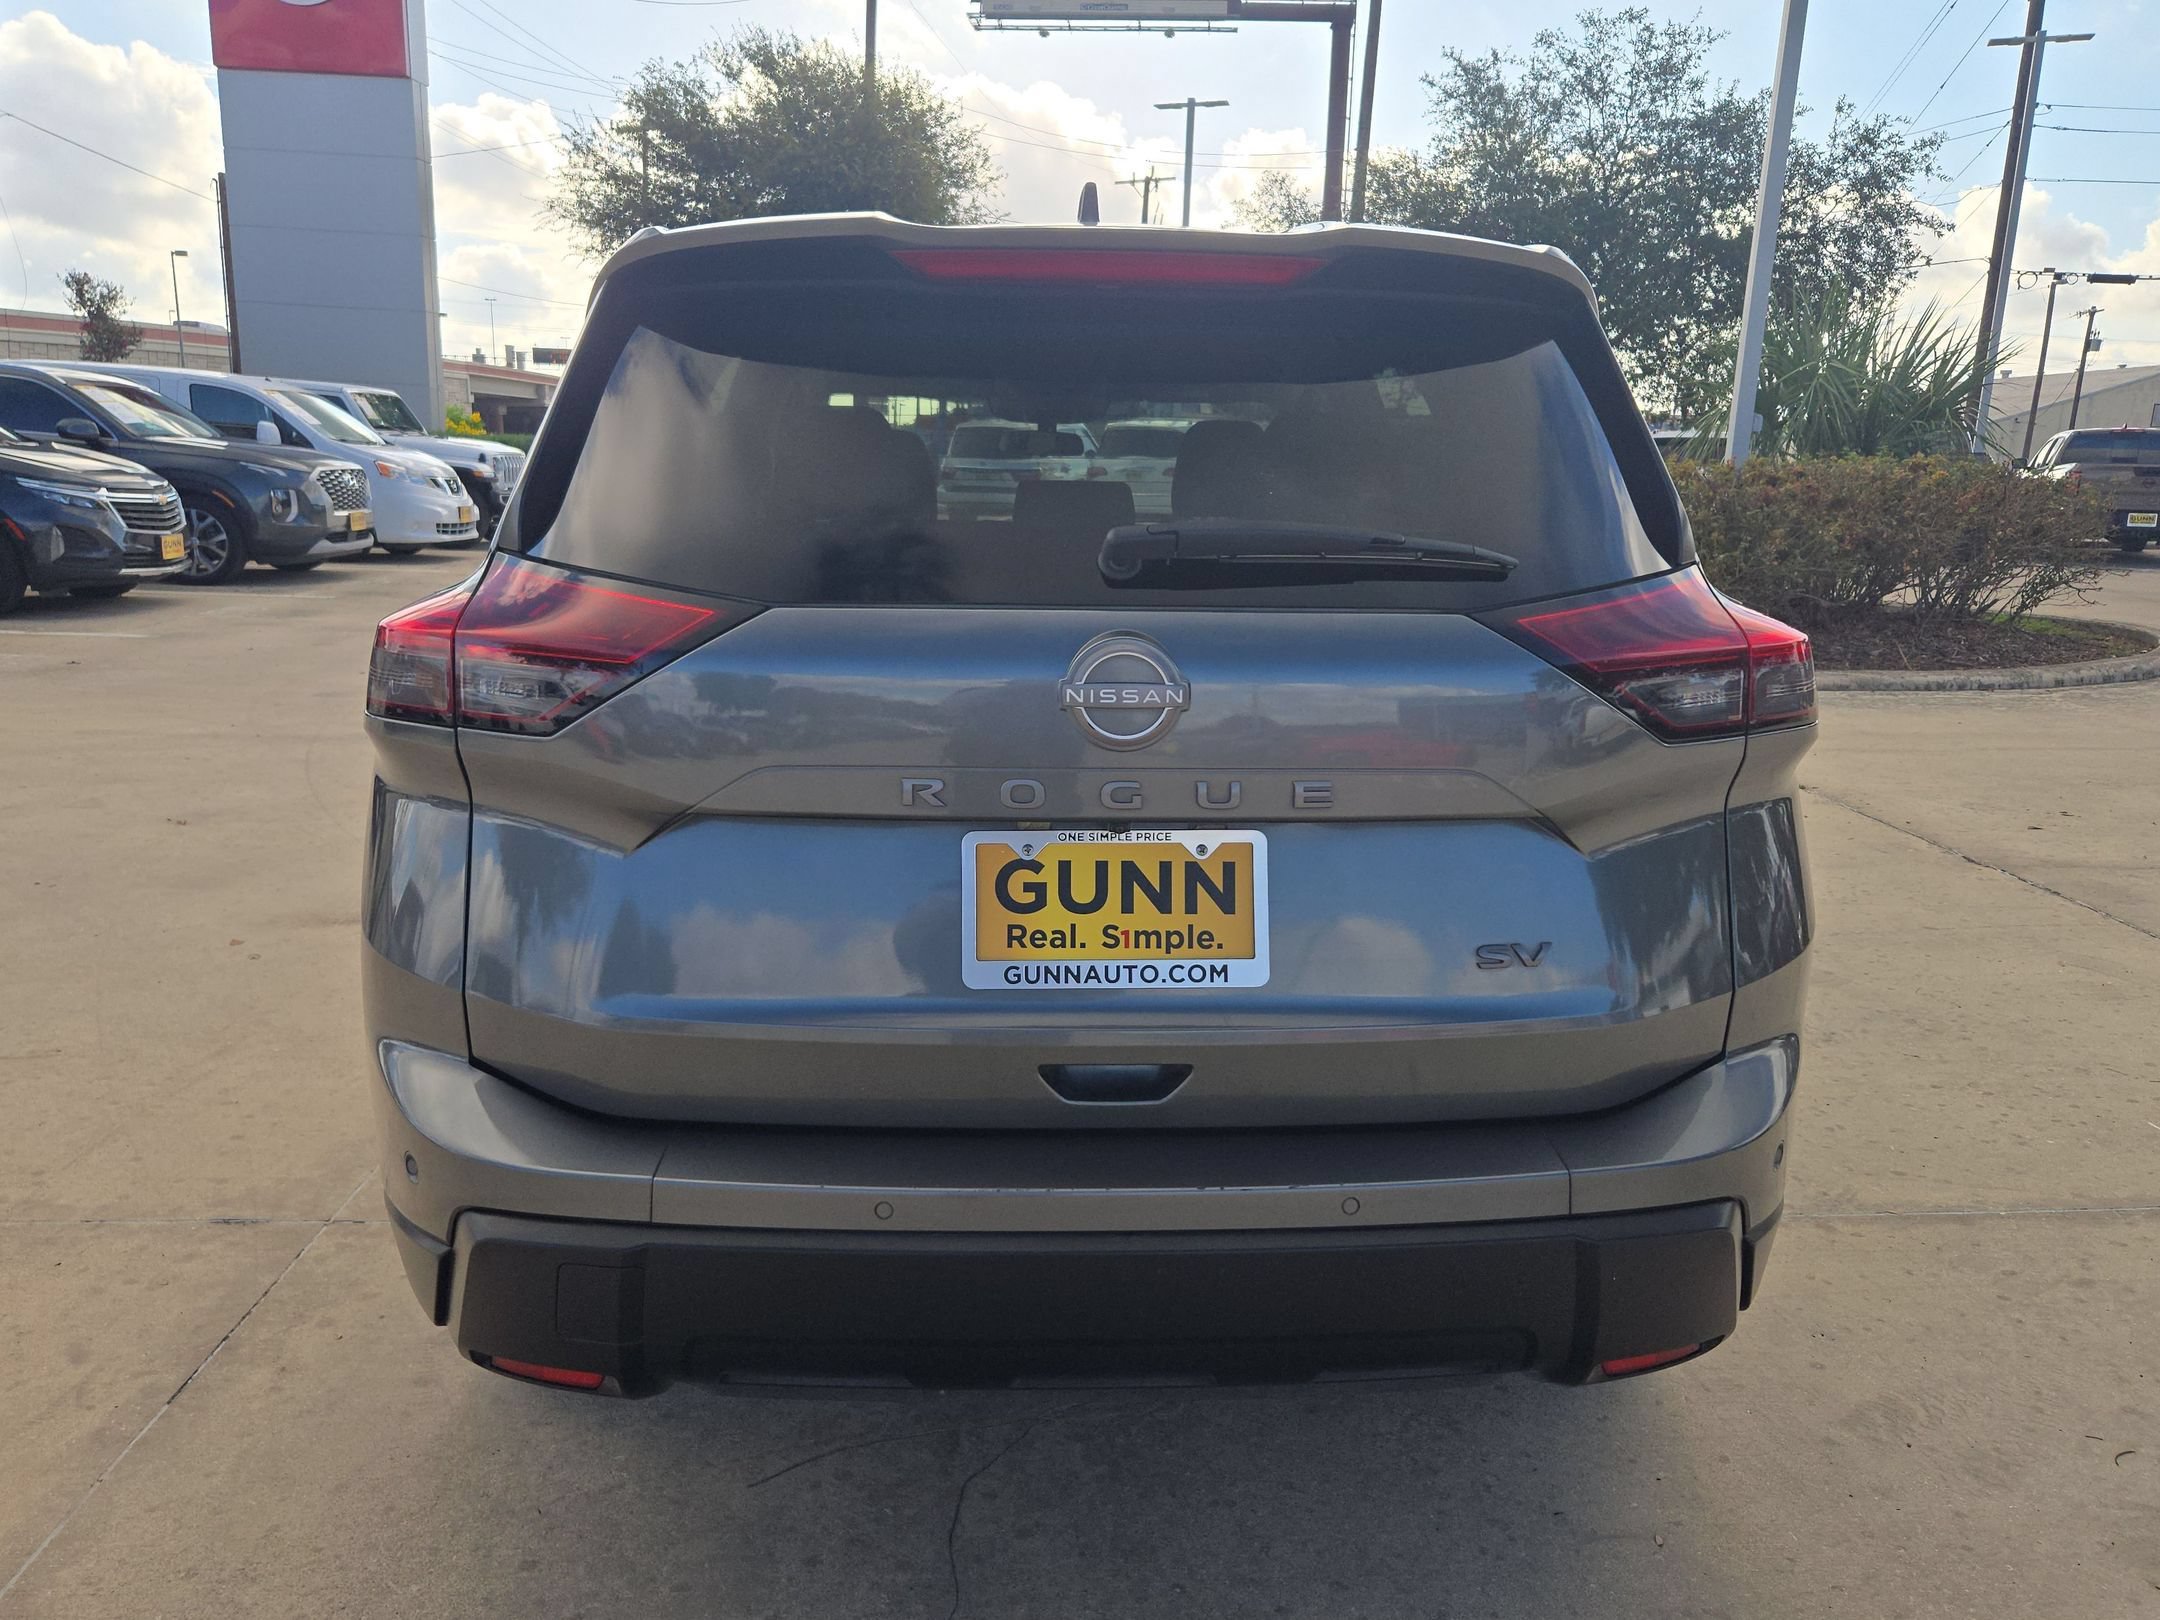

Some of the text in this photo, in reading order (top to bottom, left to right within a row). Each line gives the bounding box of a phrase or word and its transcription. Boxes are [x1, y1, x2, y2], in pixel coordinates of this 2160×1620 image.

[1066, 689, 1185, 704] NISSAN
[901, 777, 1334, 809] ROGUE
[1058, 832, 1172, 842] ONE SIMPLE PRICE
[995, 858, 1236, 915] GUNN
[1006, 923, 1086, 949] Real.
[1475, 942, 1553, 970] SV
[1003, 964, 1229, 985] GUNNAUTO.COM
